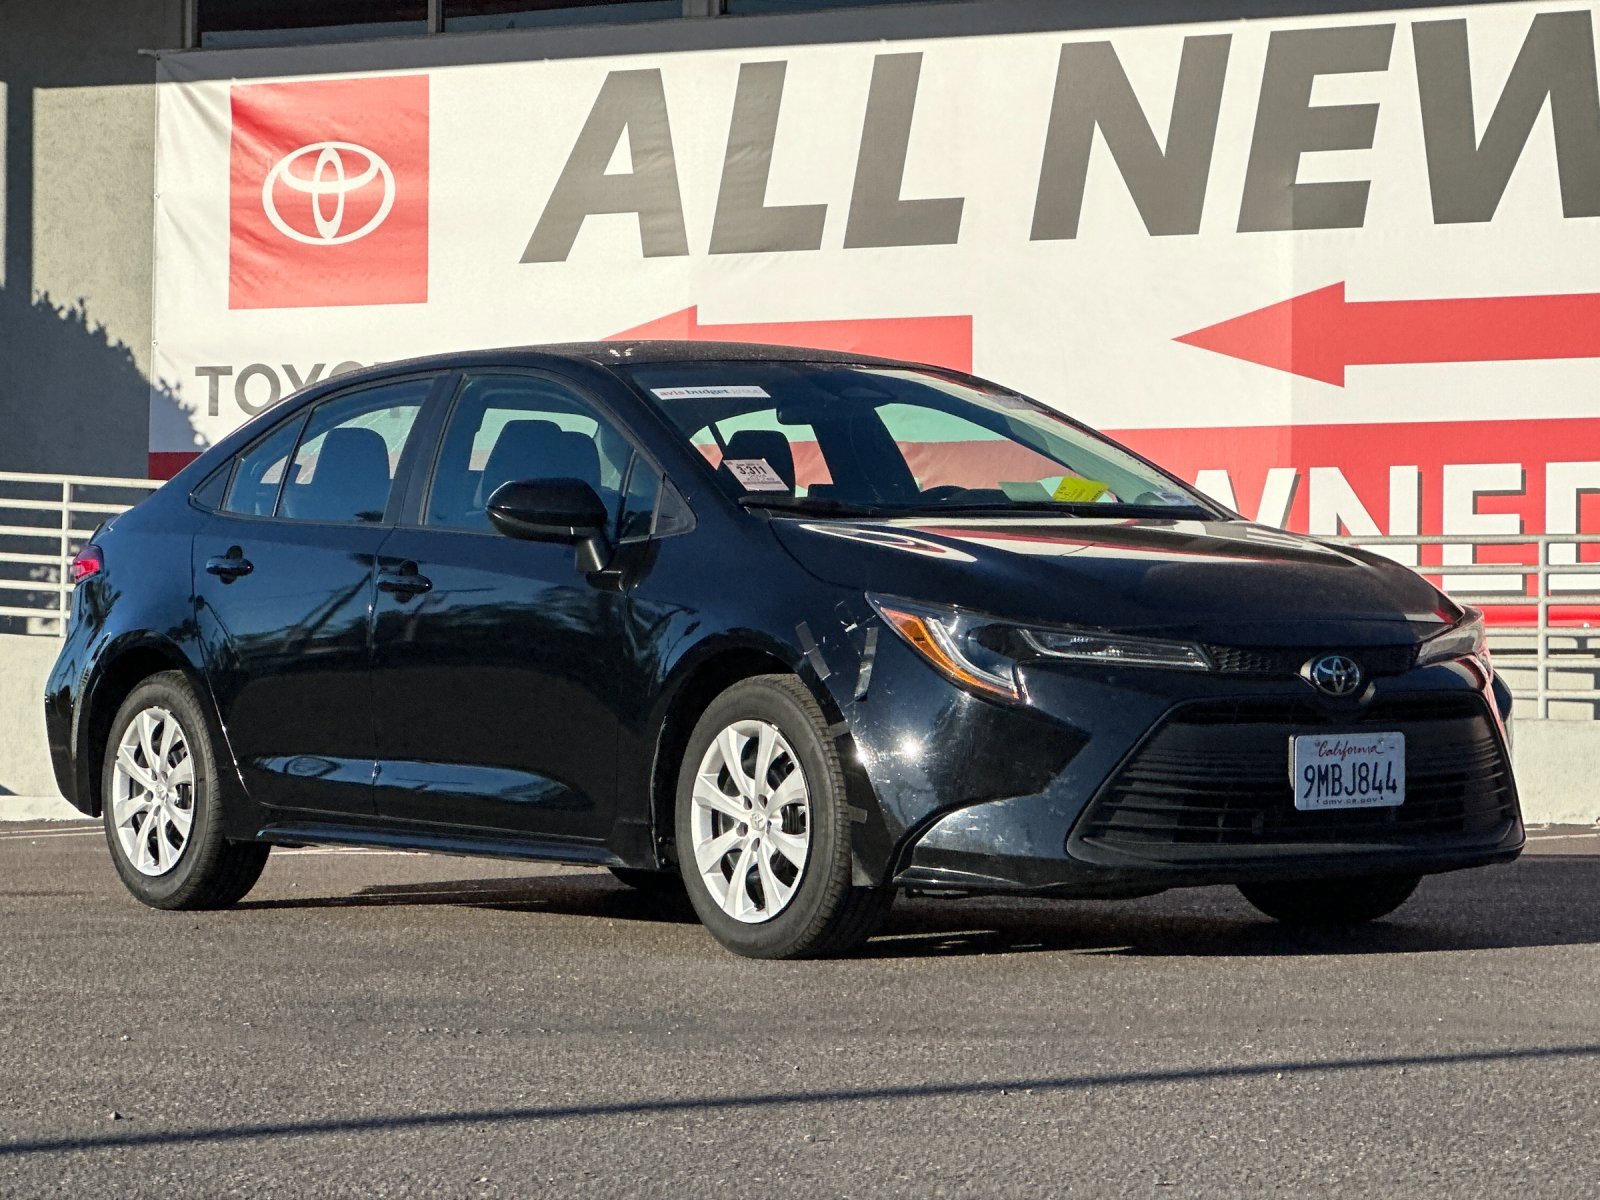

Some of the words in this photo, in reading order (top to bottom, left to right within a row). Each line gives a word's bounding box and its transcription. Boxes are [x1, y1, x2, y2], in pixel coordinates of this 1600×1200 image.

[520, 51, 964, 263] ALL
[1030, 9, 1600, 240] NEW
[1317, 739, 1384, 762] California
[1303, 760, 1398, 799] 9MBJ844
[1322, 796, 1378, 806] dmv.ca.gov
